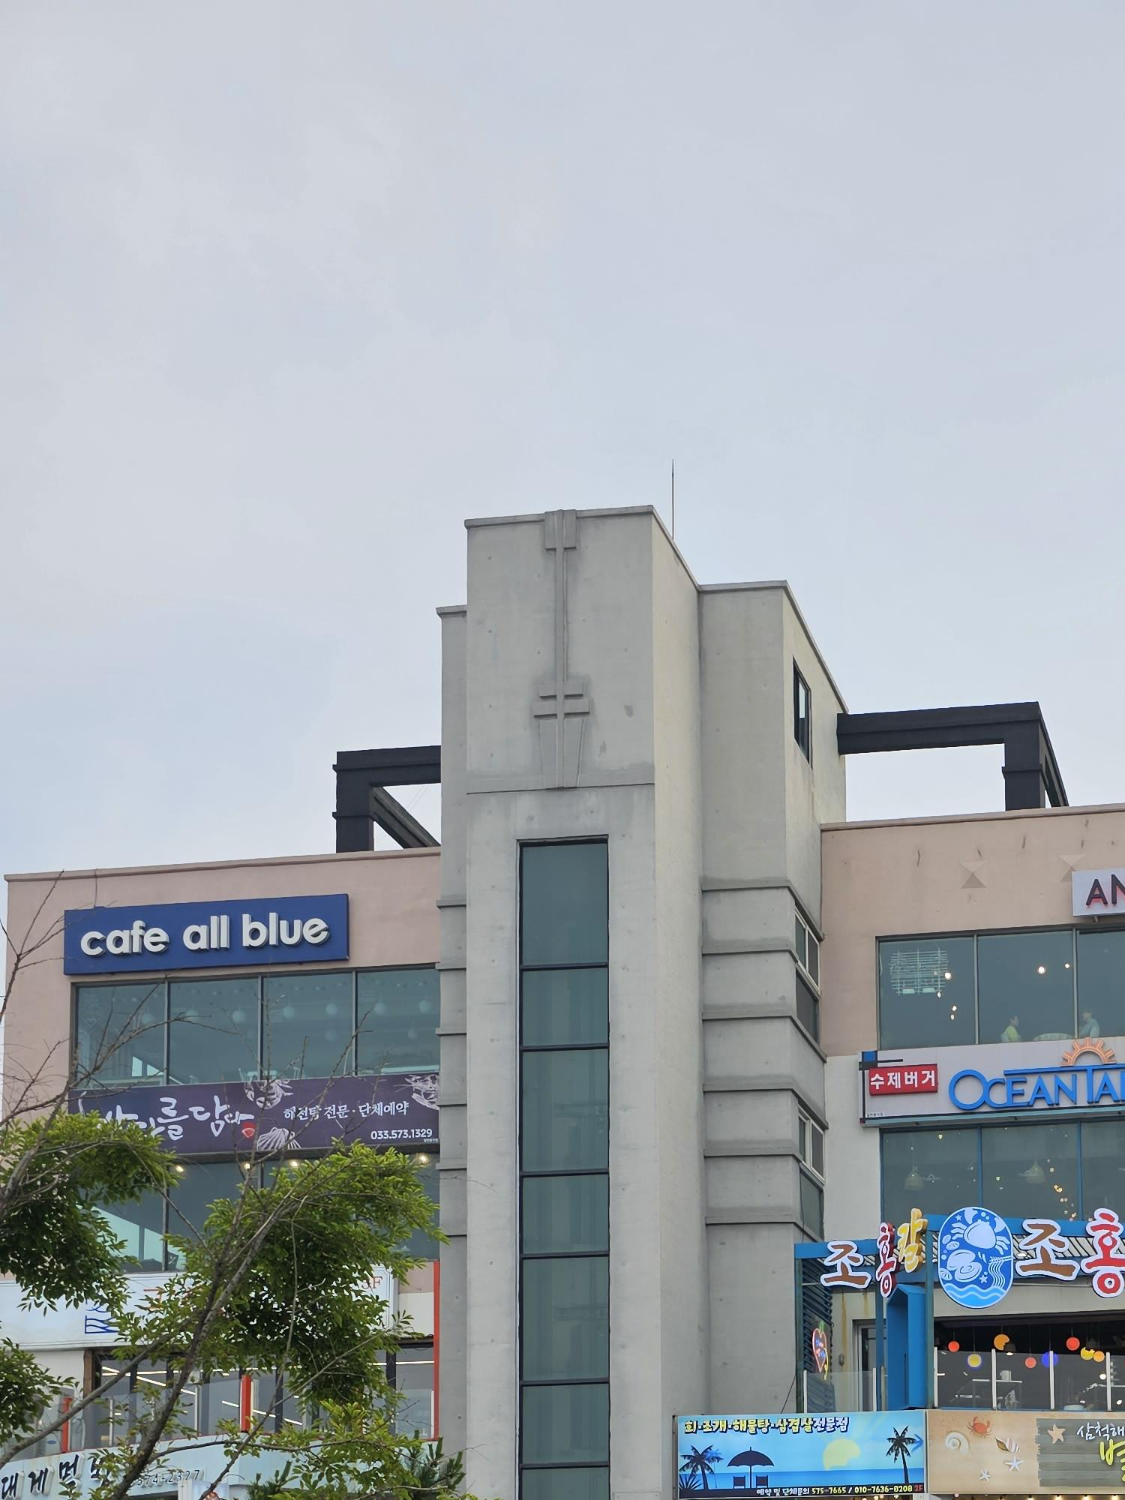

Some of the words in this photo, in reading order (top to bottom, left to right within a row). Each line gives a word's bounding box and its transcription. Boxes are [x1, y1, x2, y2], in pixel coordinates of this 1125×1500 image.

[81, 920, 169, 956] cafe
[183, 915, 230, 950] all
[242, 912, 330, 947] blue
[870, 1070, 936, 1090] 수제버거
[324, 1104, 349, 1119] 전문
[358, 1100, 410, 1118] 단체예약
[370, 1128, 433, 1140] 033.573.1329
[820, 1208, 928, 1297] 조홍칼
[812, 1486, 847, 1494] 575-7665
